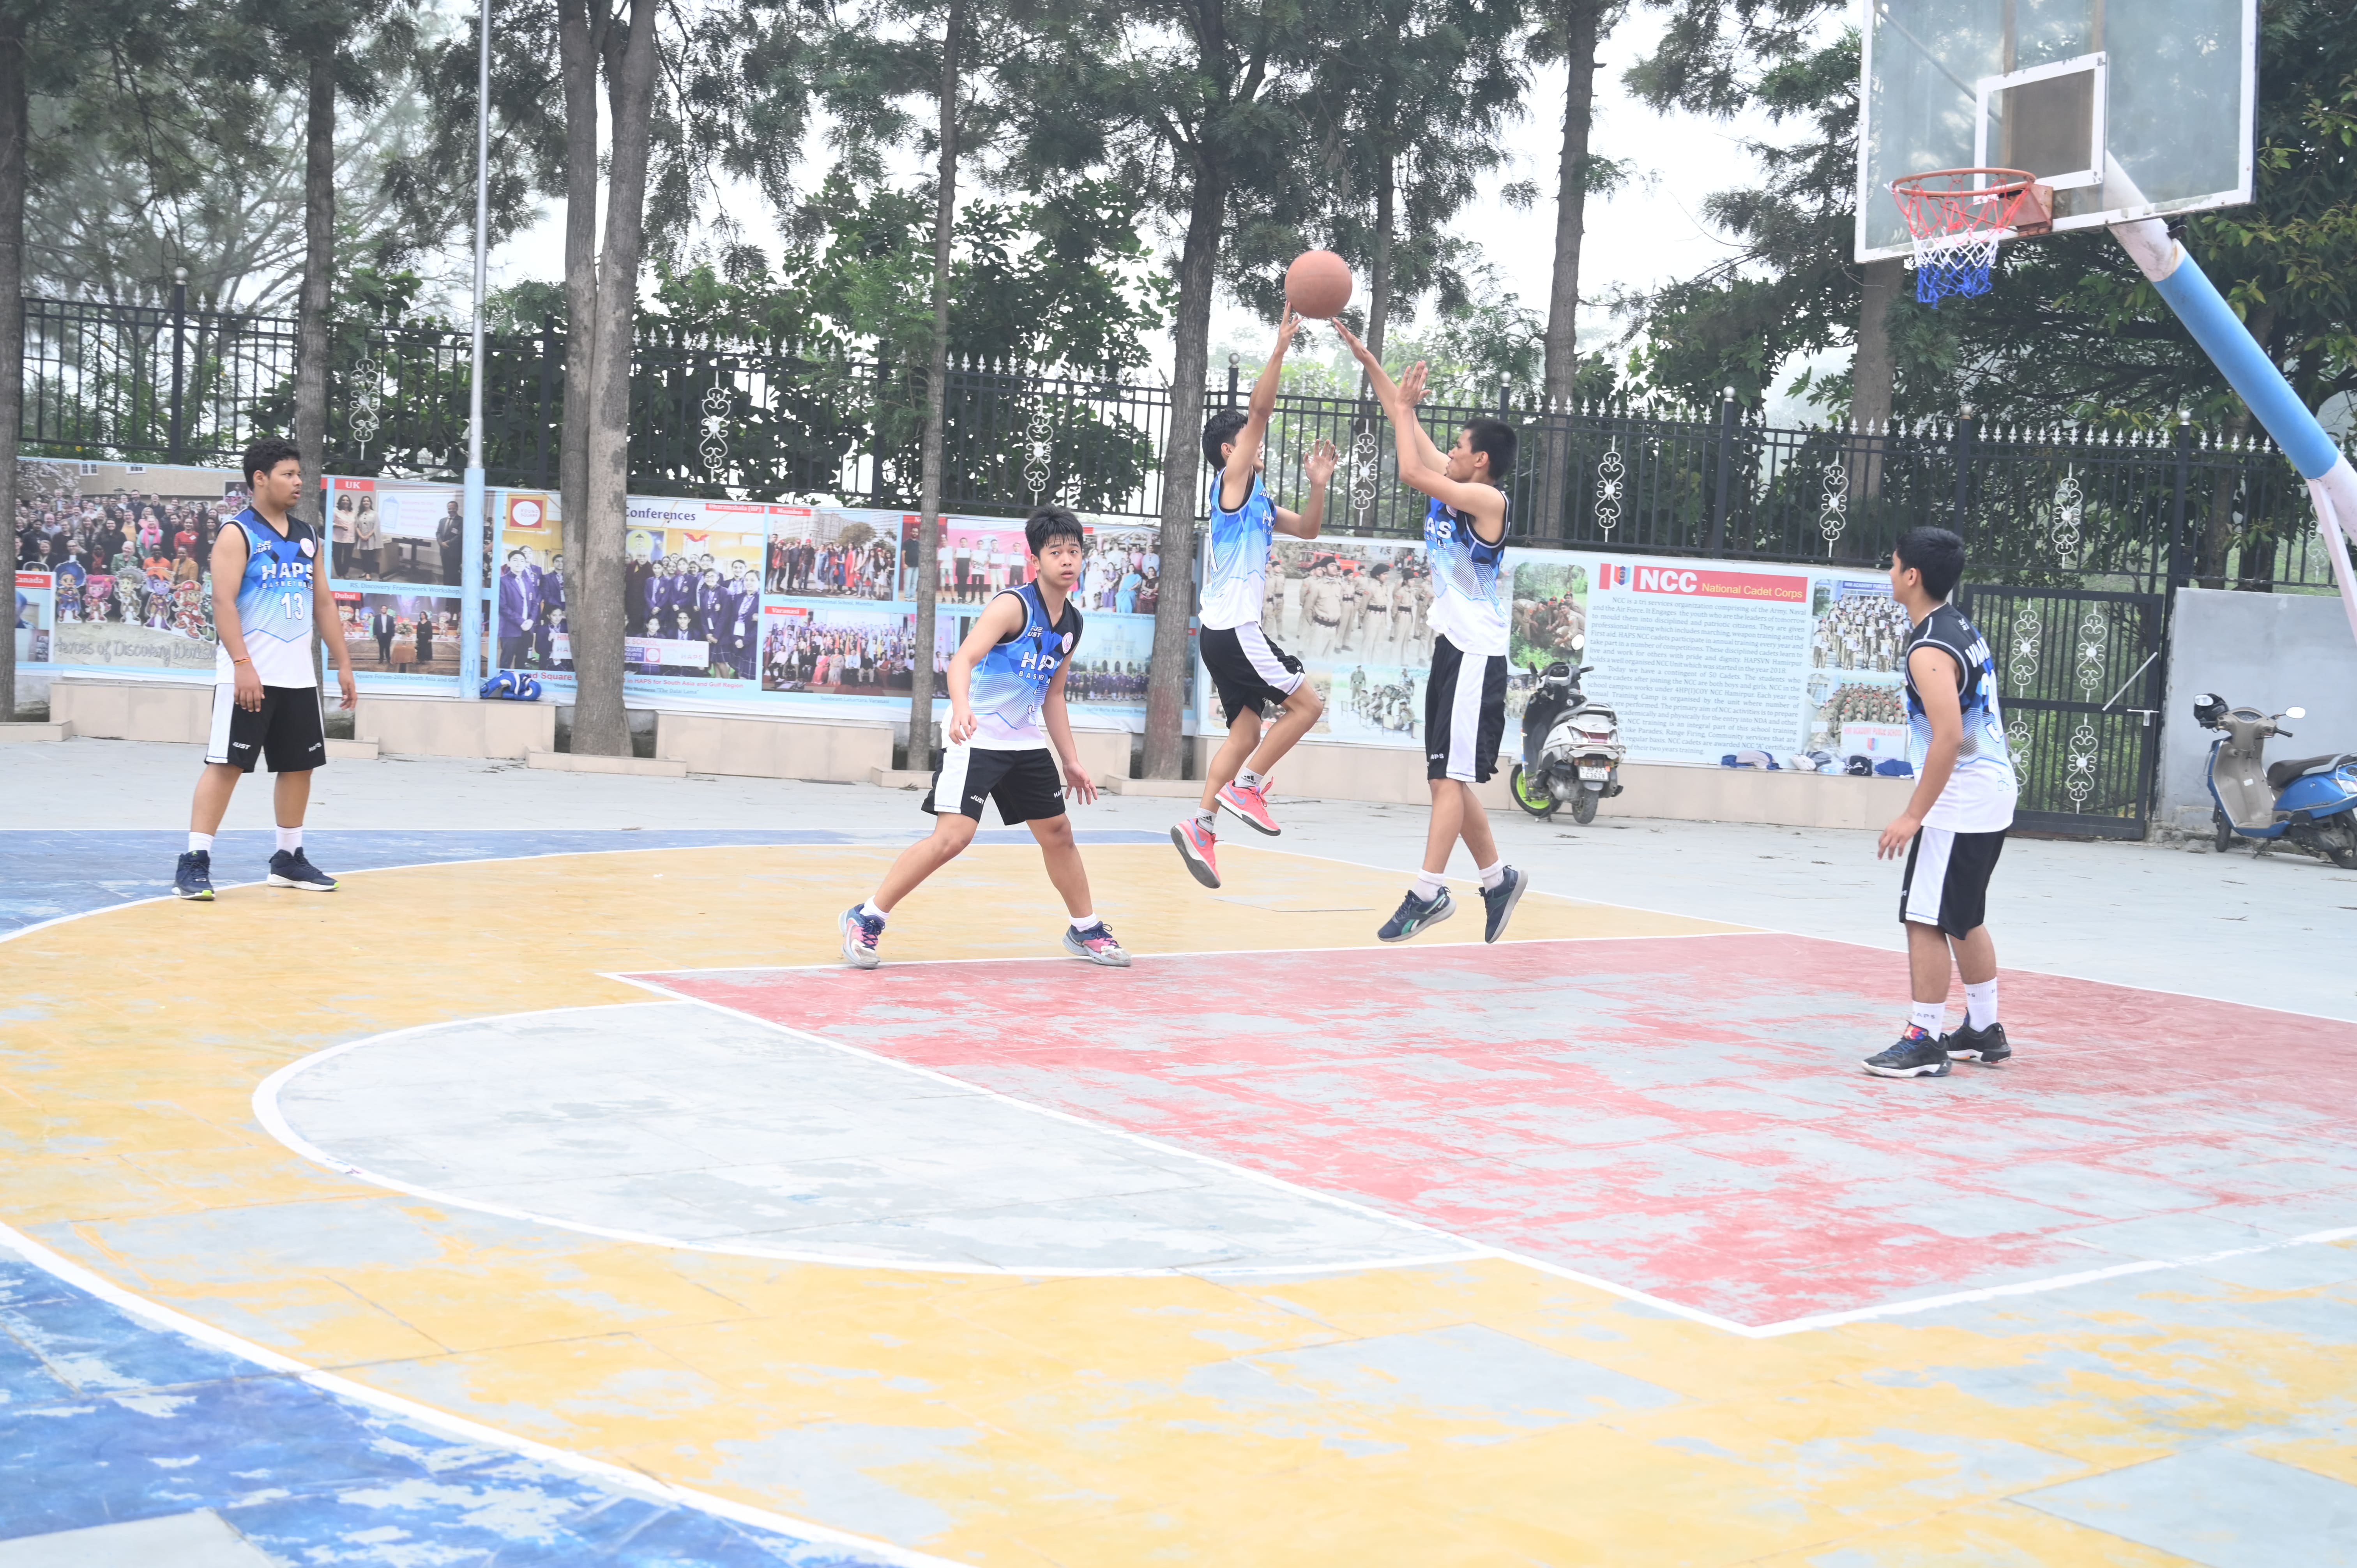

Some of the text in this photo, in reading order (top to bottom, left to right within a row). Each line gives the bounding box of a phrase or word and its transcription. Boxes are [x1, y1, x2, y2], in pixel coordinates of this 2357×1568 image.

[254, 545, 272, 554] JUST
[1640, 569, 1803, 599] NCC National Cadet Corps
[281, 592, 304, 620] 13
[1715, 605, 1749, 613] comprising
[1655, 617, 1688, 625] disciplined
[1757, 633, 1781, 641] training
[97, 639, 111, 662] of
[114, 639, 171, 667] Discovery
[1772, 659, 1802, 667] Hamirpur
[1612, 692, 1638, 700] Training
[1641, 694, 1658, 702] Camp
[1708, 731, 1744, 741] Community
